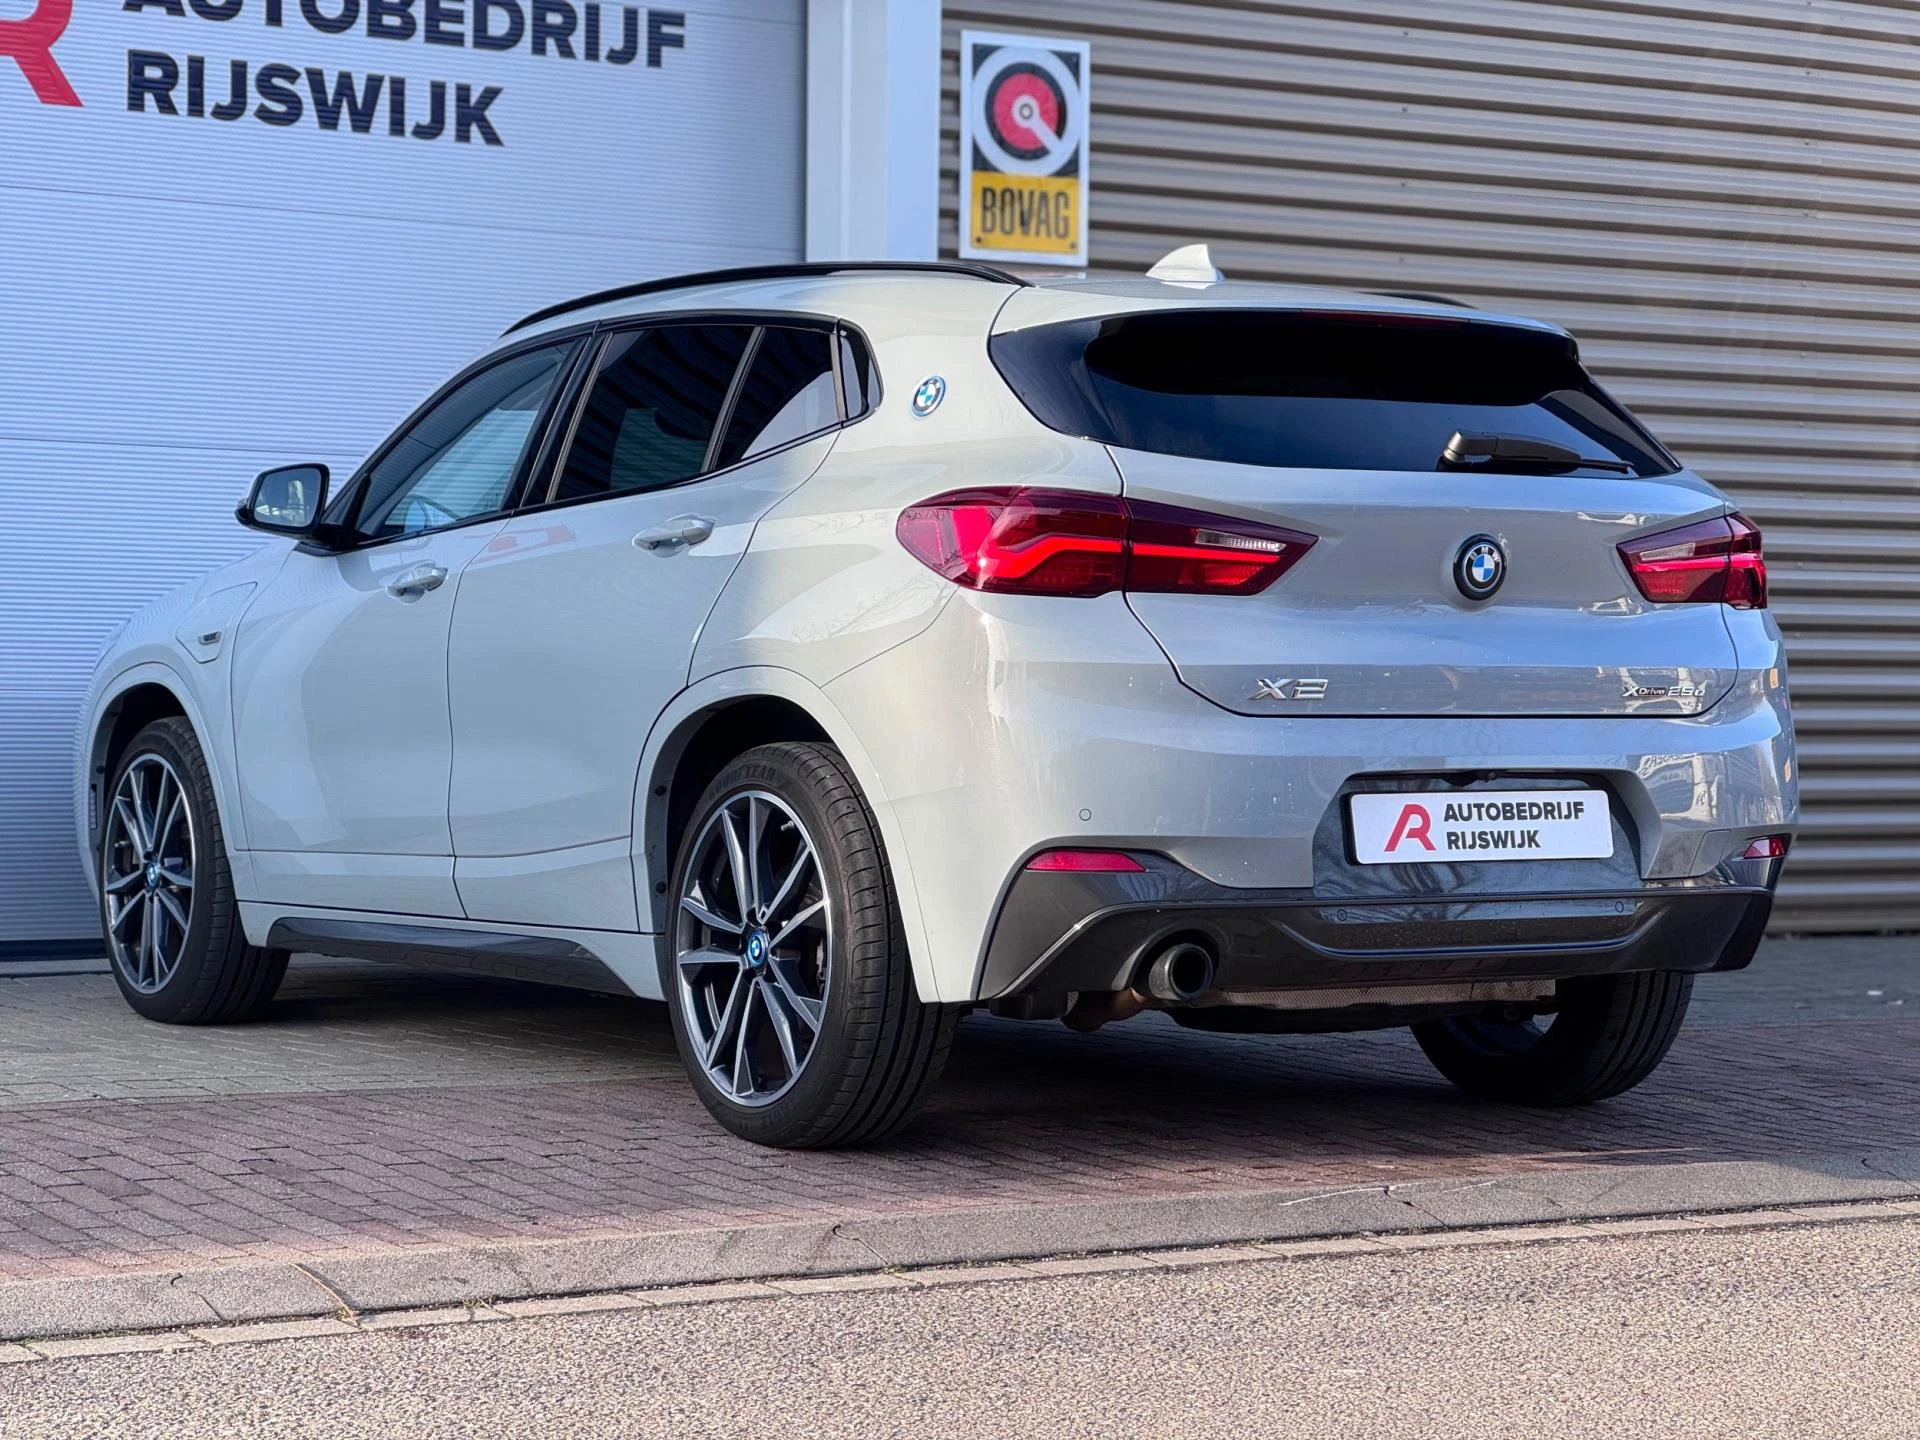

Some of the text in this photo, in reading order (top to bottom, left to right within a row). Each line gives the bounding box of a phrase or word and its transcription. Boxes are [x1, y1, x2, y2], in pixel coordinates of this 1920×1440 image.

[122, 0, 686, 68] OBEDRIJF
[127, 49, 504, 146] RIJSWIJK
[981, 186, 1070, 239] BOVAG
[1247, 678, 1329, 700] X2
[1444, 801, 1584, 822] AUTOBEDRIJF
[1446, 830, 1541, 850] RIJSWIJK
